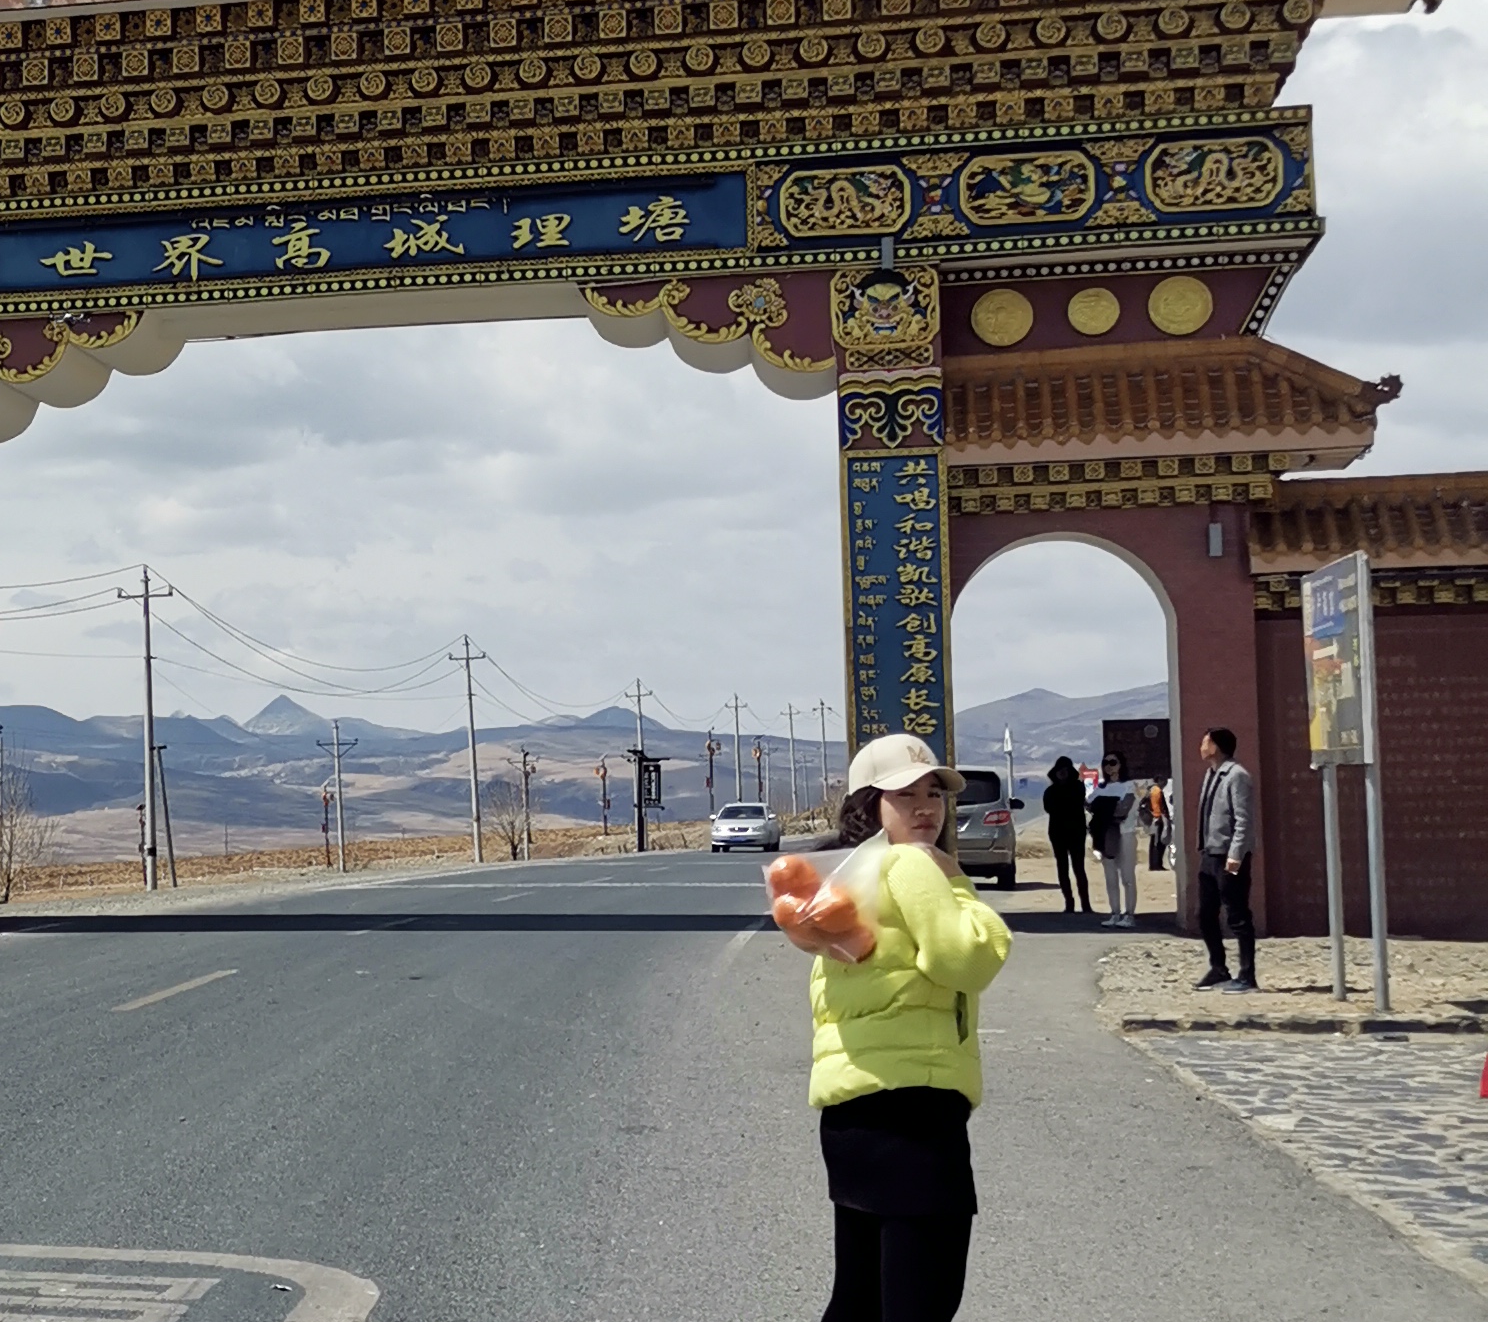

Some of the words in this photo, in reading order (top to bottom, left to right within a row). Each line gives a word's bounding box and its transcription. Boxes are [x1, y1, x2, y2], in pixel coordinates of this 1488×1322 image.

[40, 196, 691, 281] 世界高城理塘
